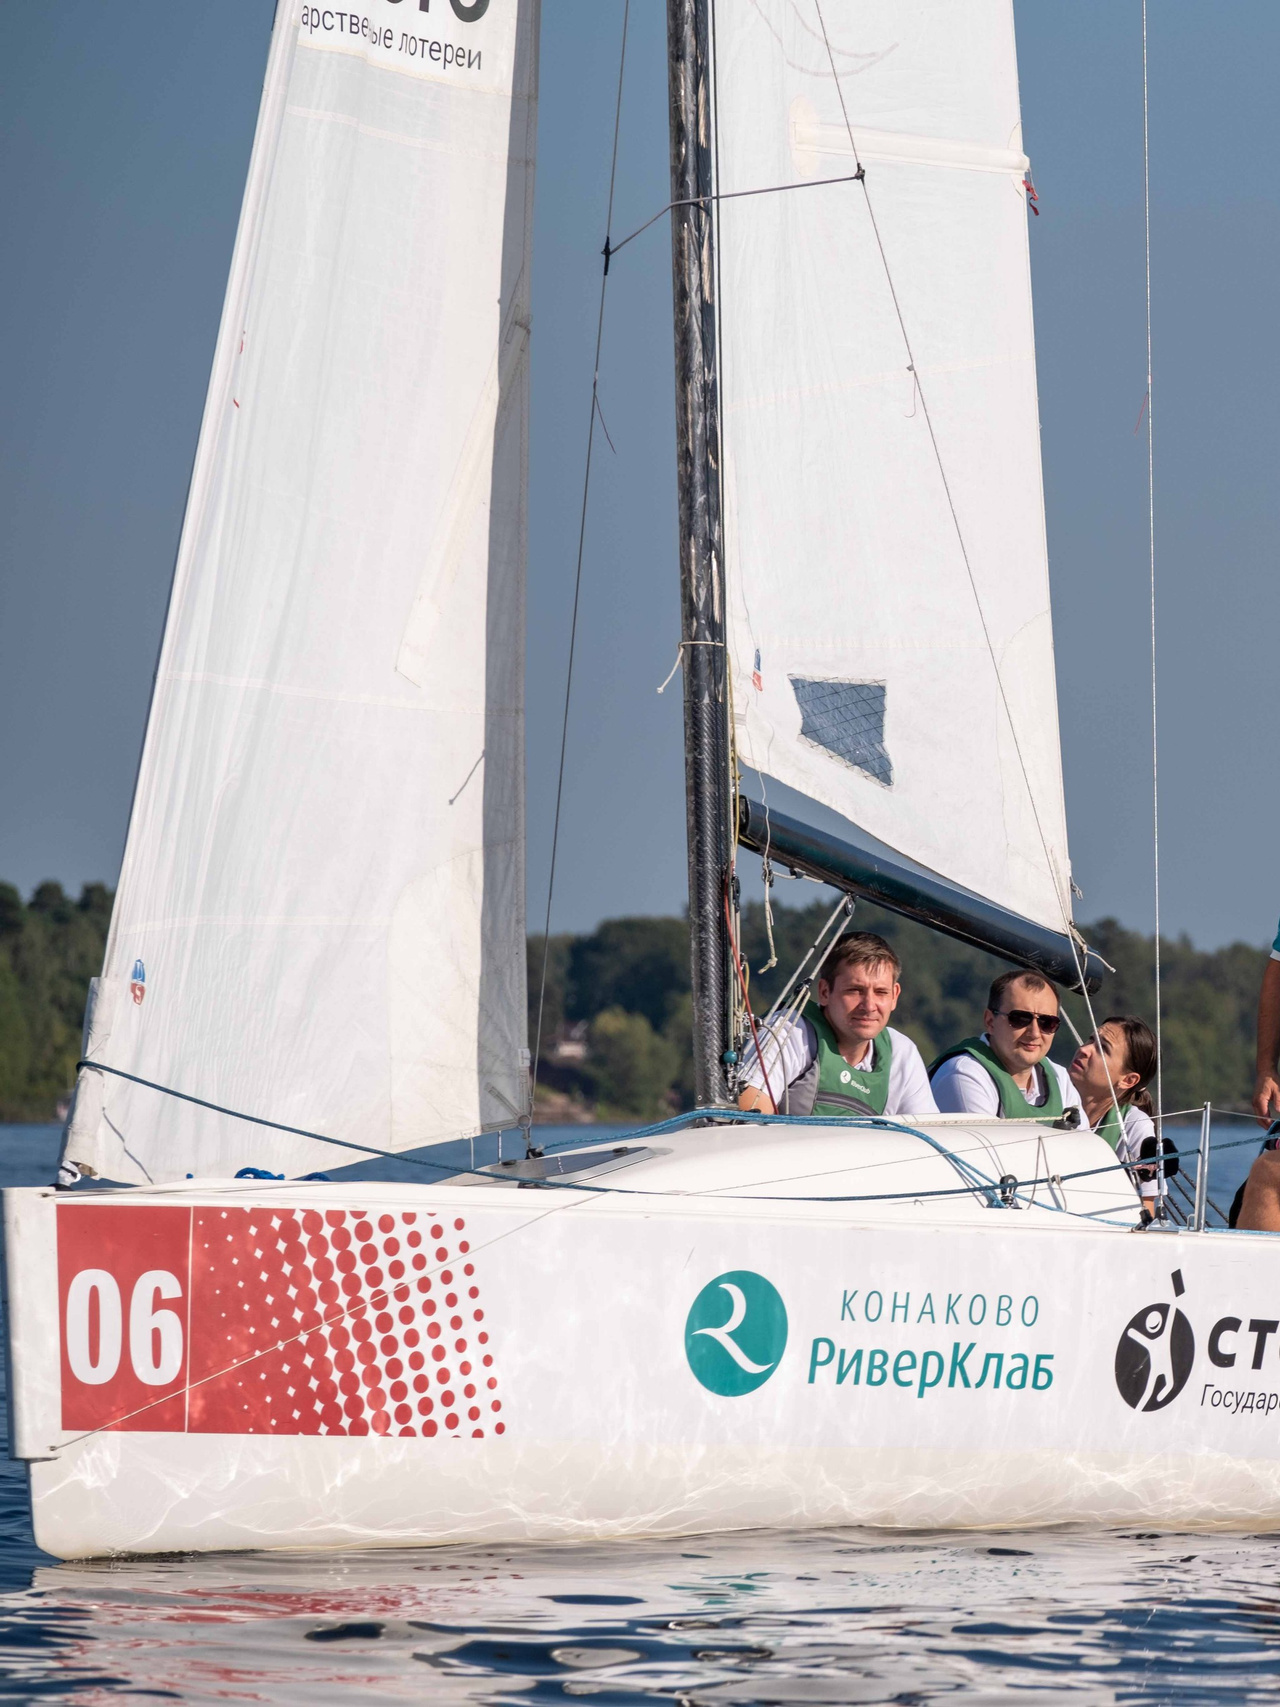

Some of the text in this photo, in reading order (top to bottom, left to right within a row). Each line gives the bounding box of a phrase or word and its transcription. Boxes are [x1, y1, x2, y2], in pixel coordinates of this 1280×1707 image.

[398, 32, 482, 70] лотереи
[66, 1268, 184, 1386] 06
[841, 1290, 1039, 1327] КОНАКОВО
[808, 1337, 1054, 1399] РиверКлаб
